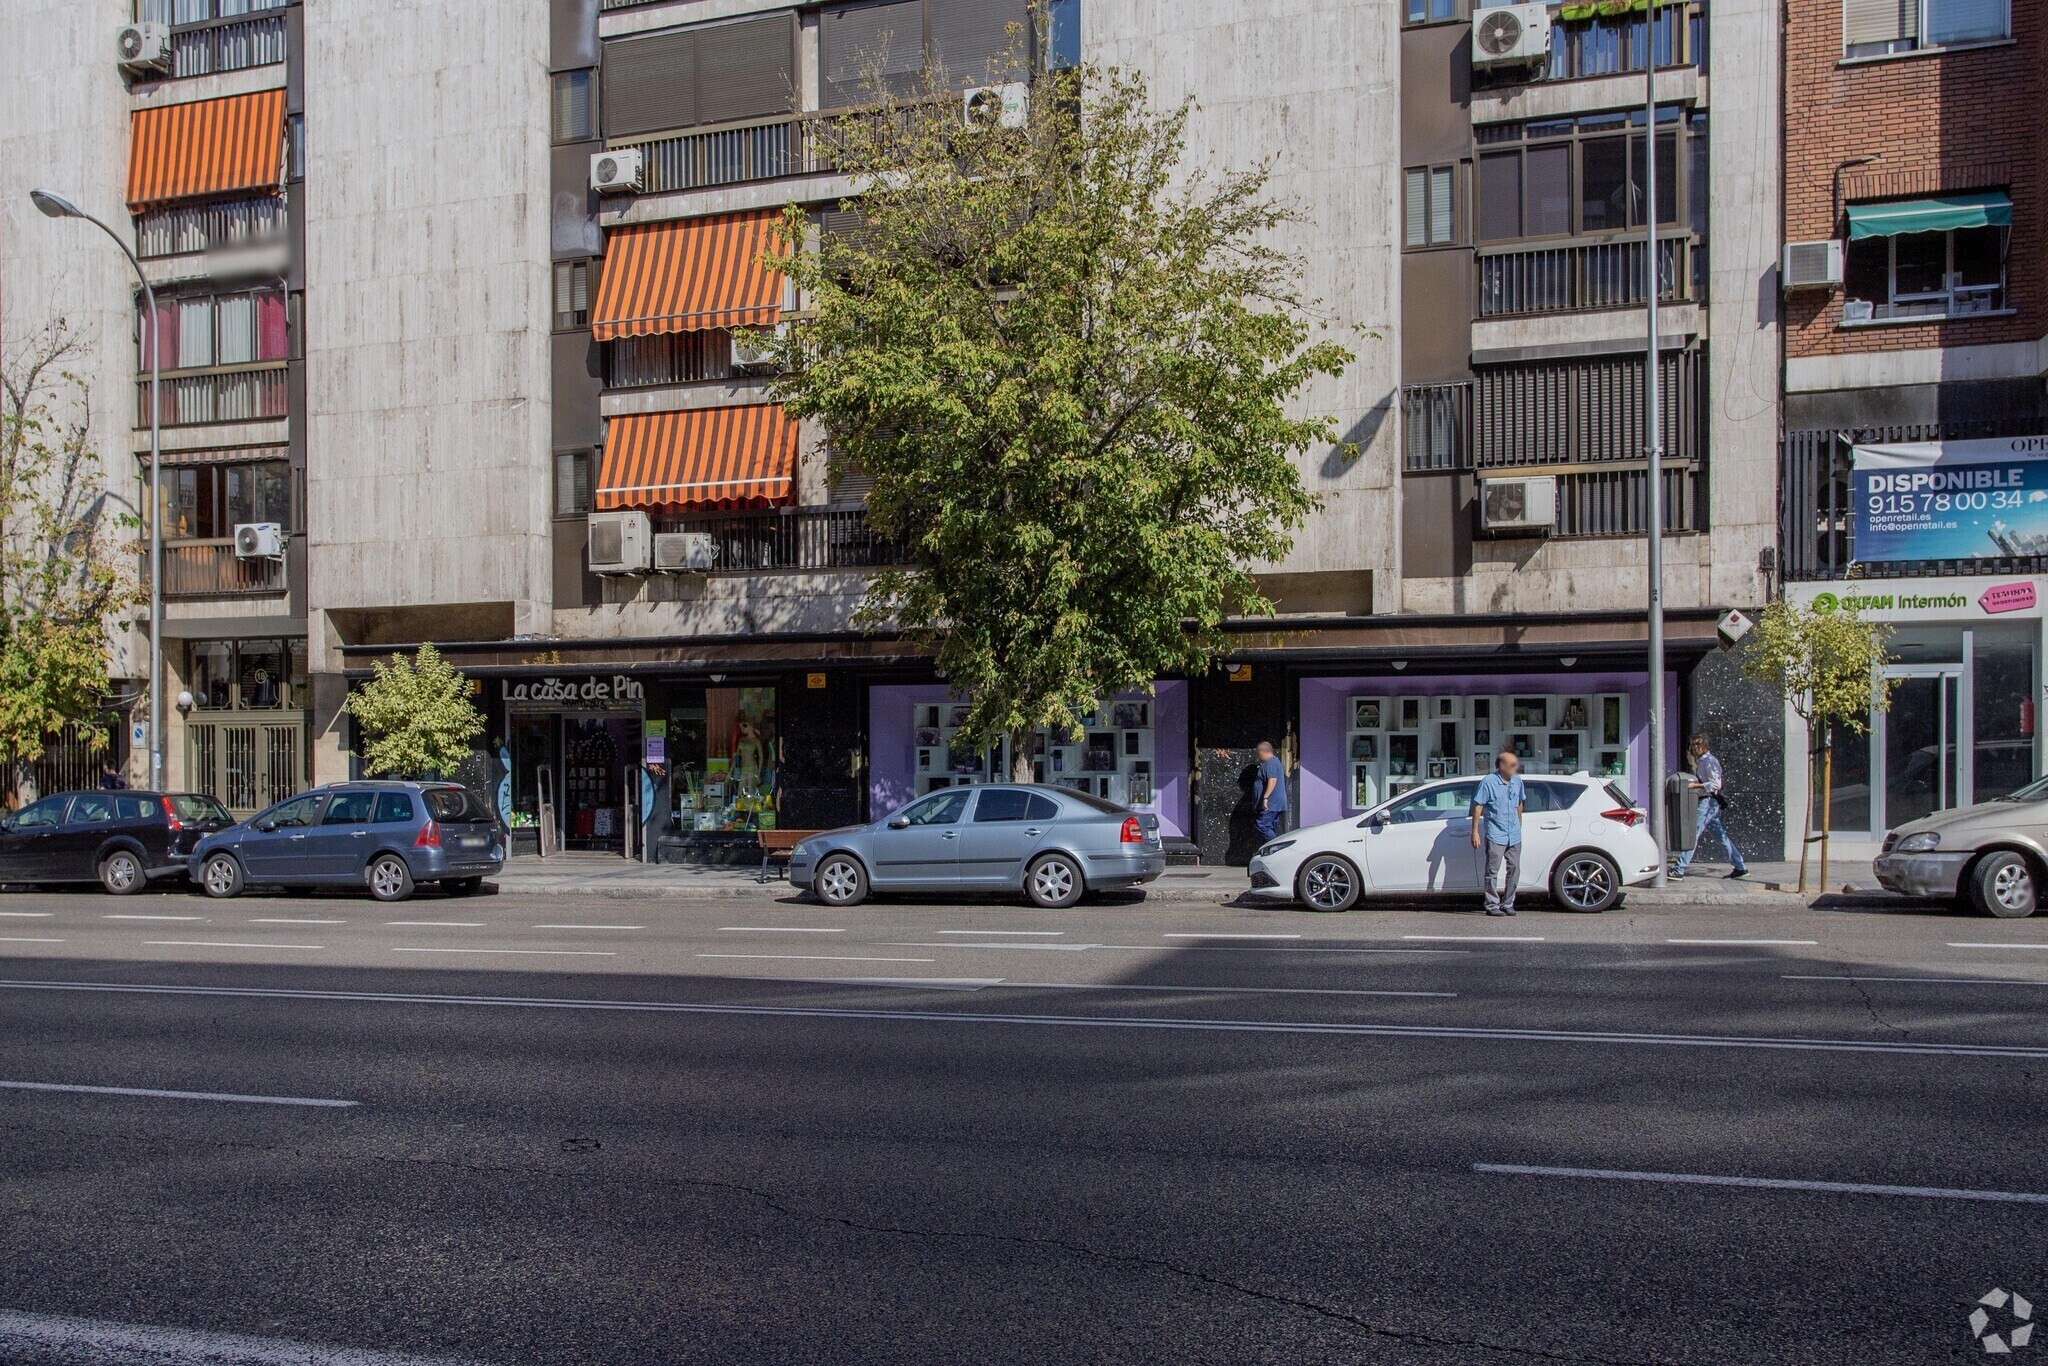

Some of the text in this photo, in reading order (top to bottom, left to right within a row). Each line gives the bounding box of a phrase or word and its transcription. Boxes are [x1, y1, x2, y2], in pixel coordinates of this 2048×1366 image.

[1868, 468, 2024, 493] DISPONIBLE
[1868, 489, 2023, 514] 915 78 00 34
[1869, 513, 1931, 524] openretail.es
[1869, 521, 1957, 532] info@openretail.es
[1898, 593, 1967, 609] Intermón
[502, 675, 644, 700] La casa de Pin
